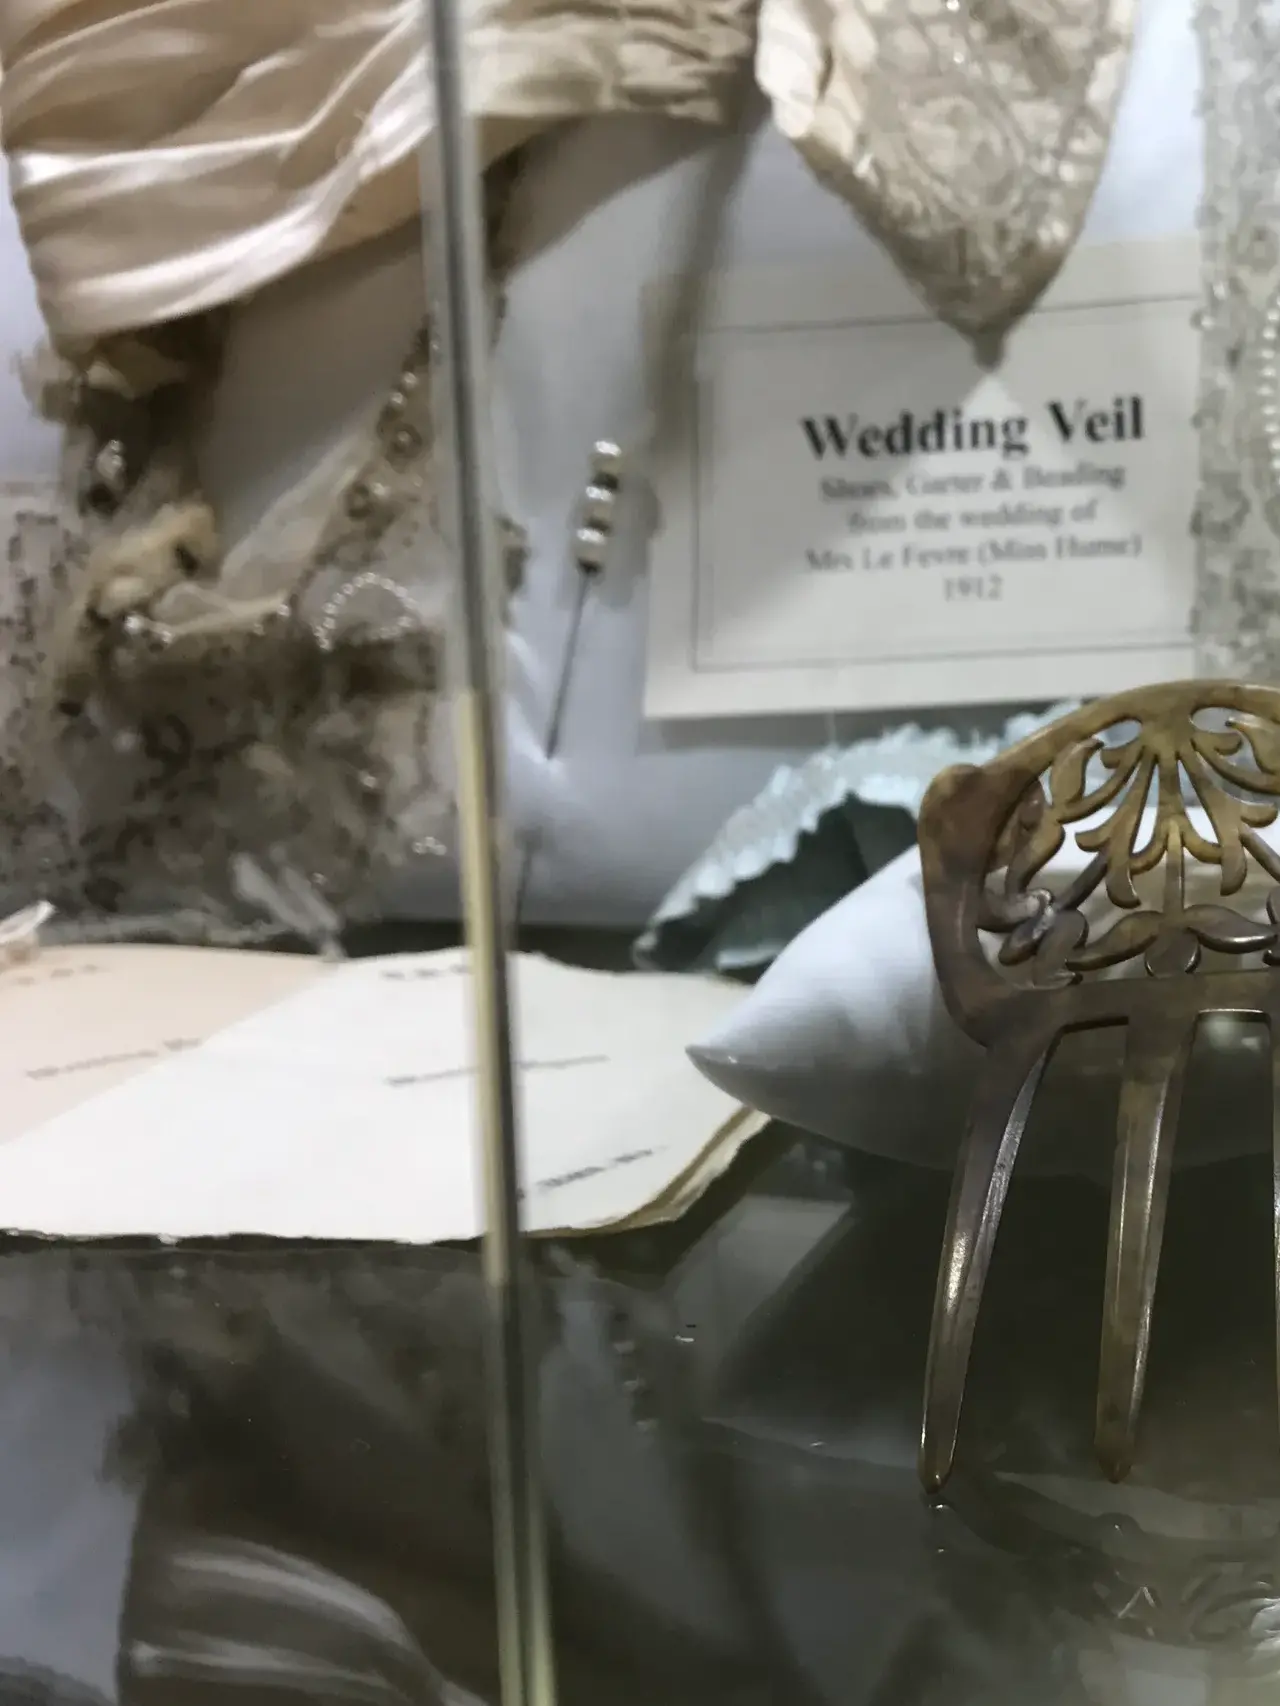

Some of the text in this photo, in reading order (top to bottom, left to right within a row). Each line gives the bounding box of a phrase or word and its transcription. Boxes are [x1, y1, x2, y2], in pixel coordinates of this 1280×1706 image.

[801, 394, 1144, 461] Wedding Veil
[990, 468, 1013, 491] &
[849, 499, 1097, 536] from the wedding of
[944, 573, 1004, 602] 1912
